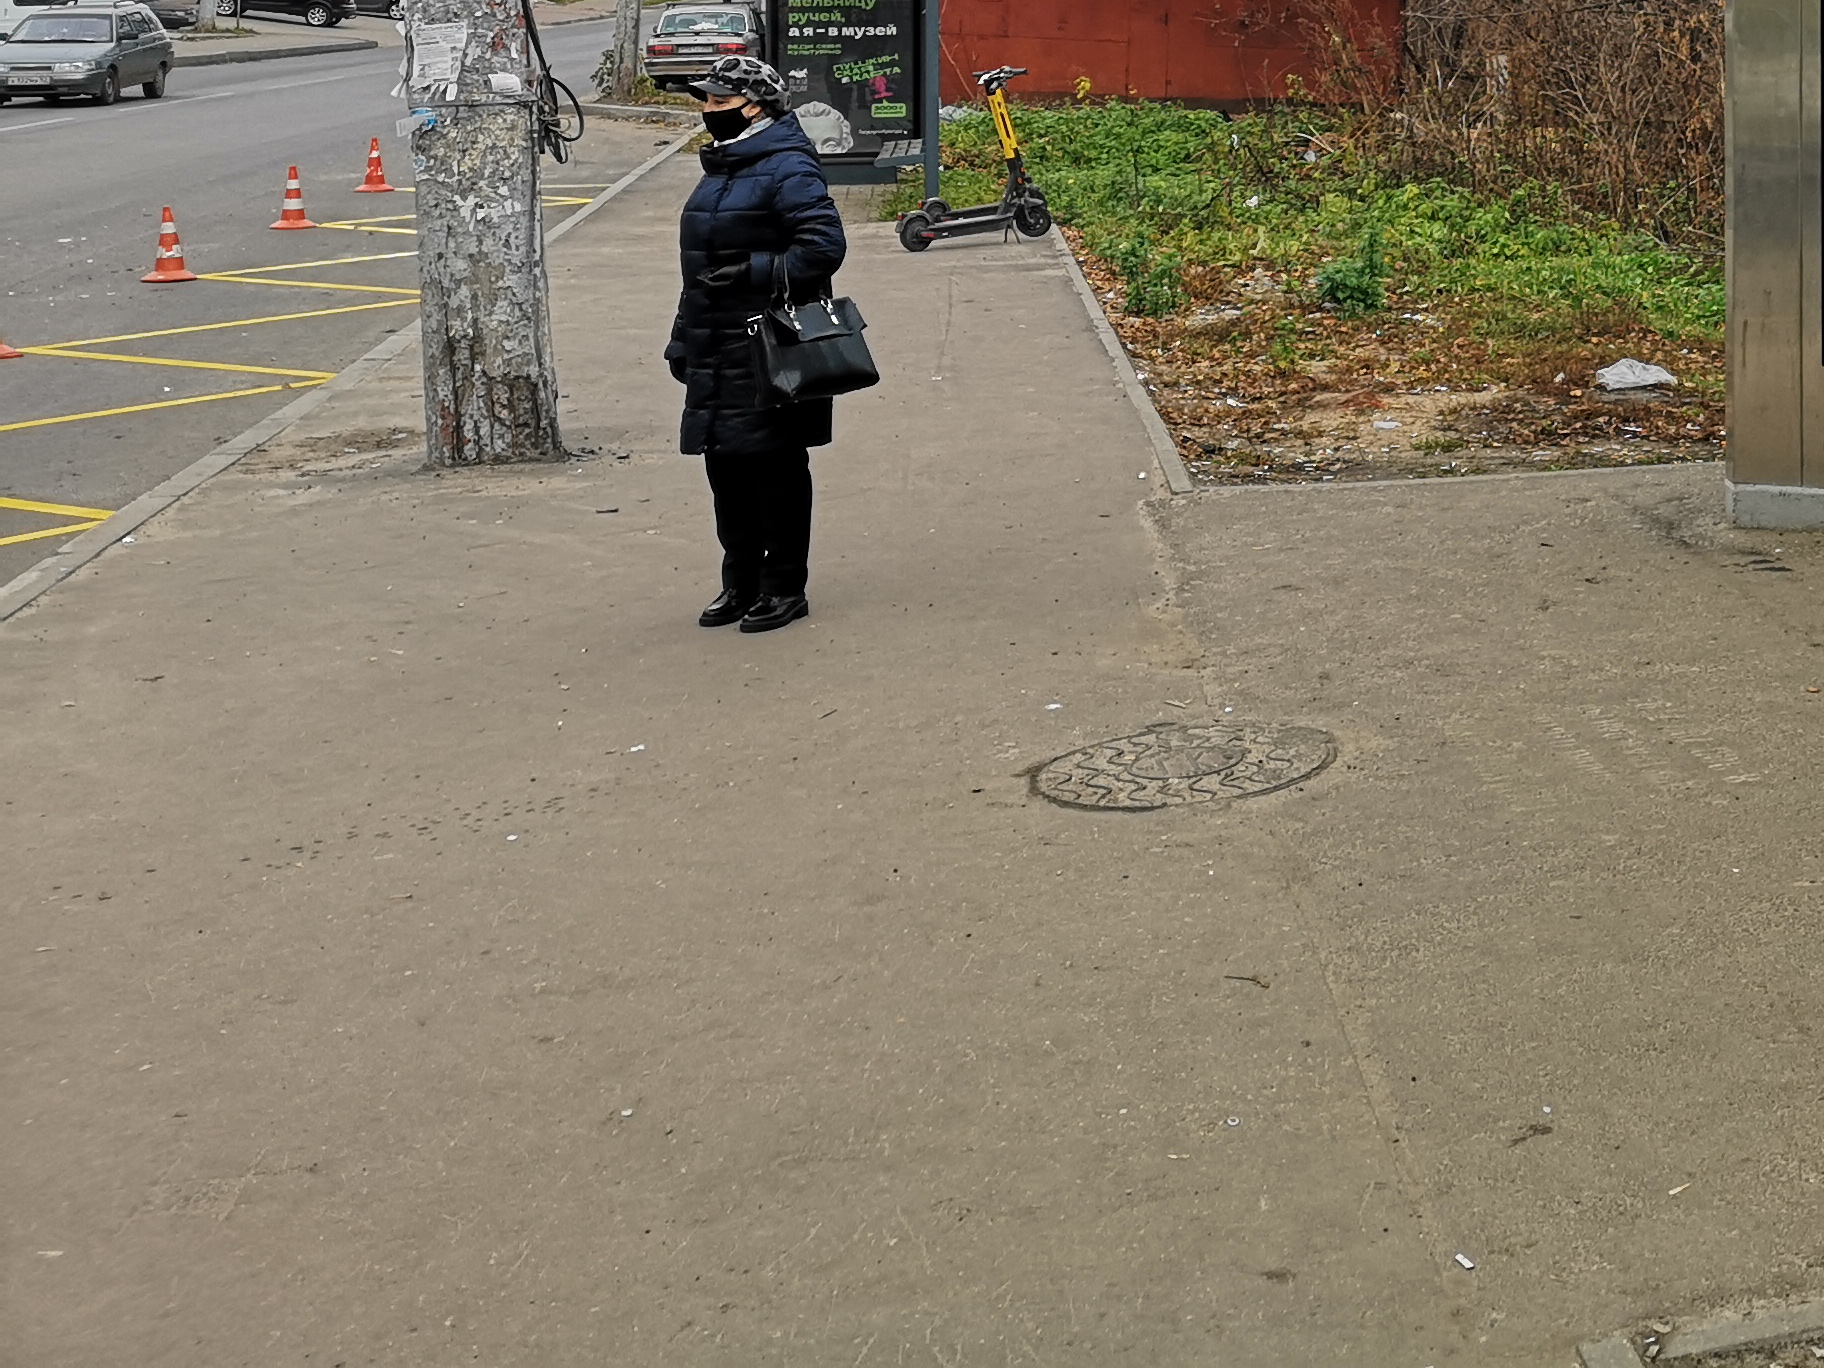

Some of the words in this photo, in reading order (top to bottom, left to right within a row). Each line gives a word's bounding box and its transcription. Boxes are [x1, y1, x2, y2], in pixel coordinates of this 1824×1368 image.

[788, 10, 846, 25] ручей,
[788, 26, 800, 37] а
[802, 26, 814, 37] я
[828, 26, 839, 36] в
[841, 23, 897, 40] музей
